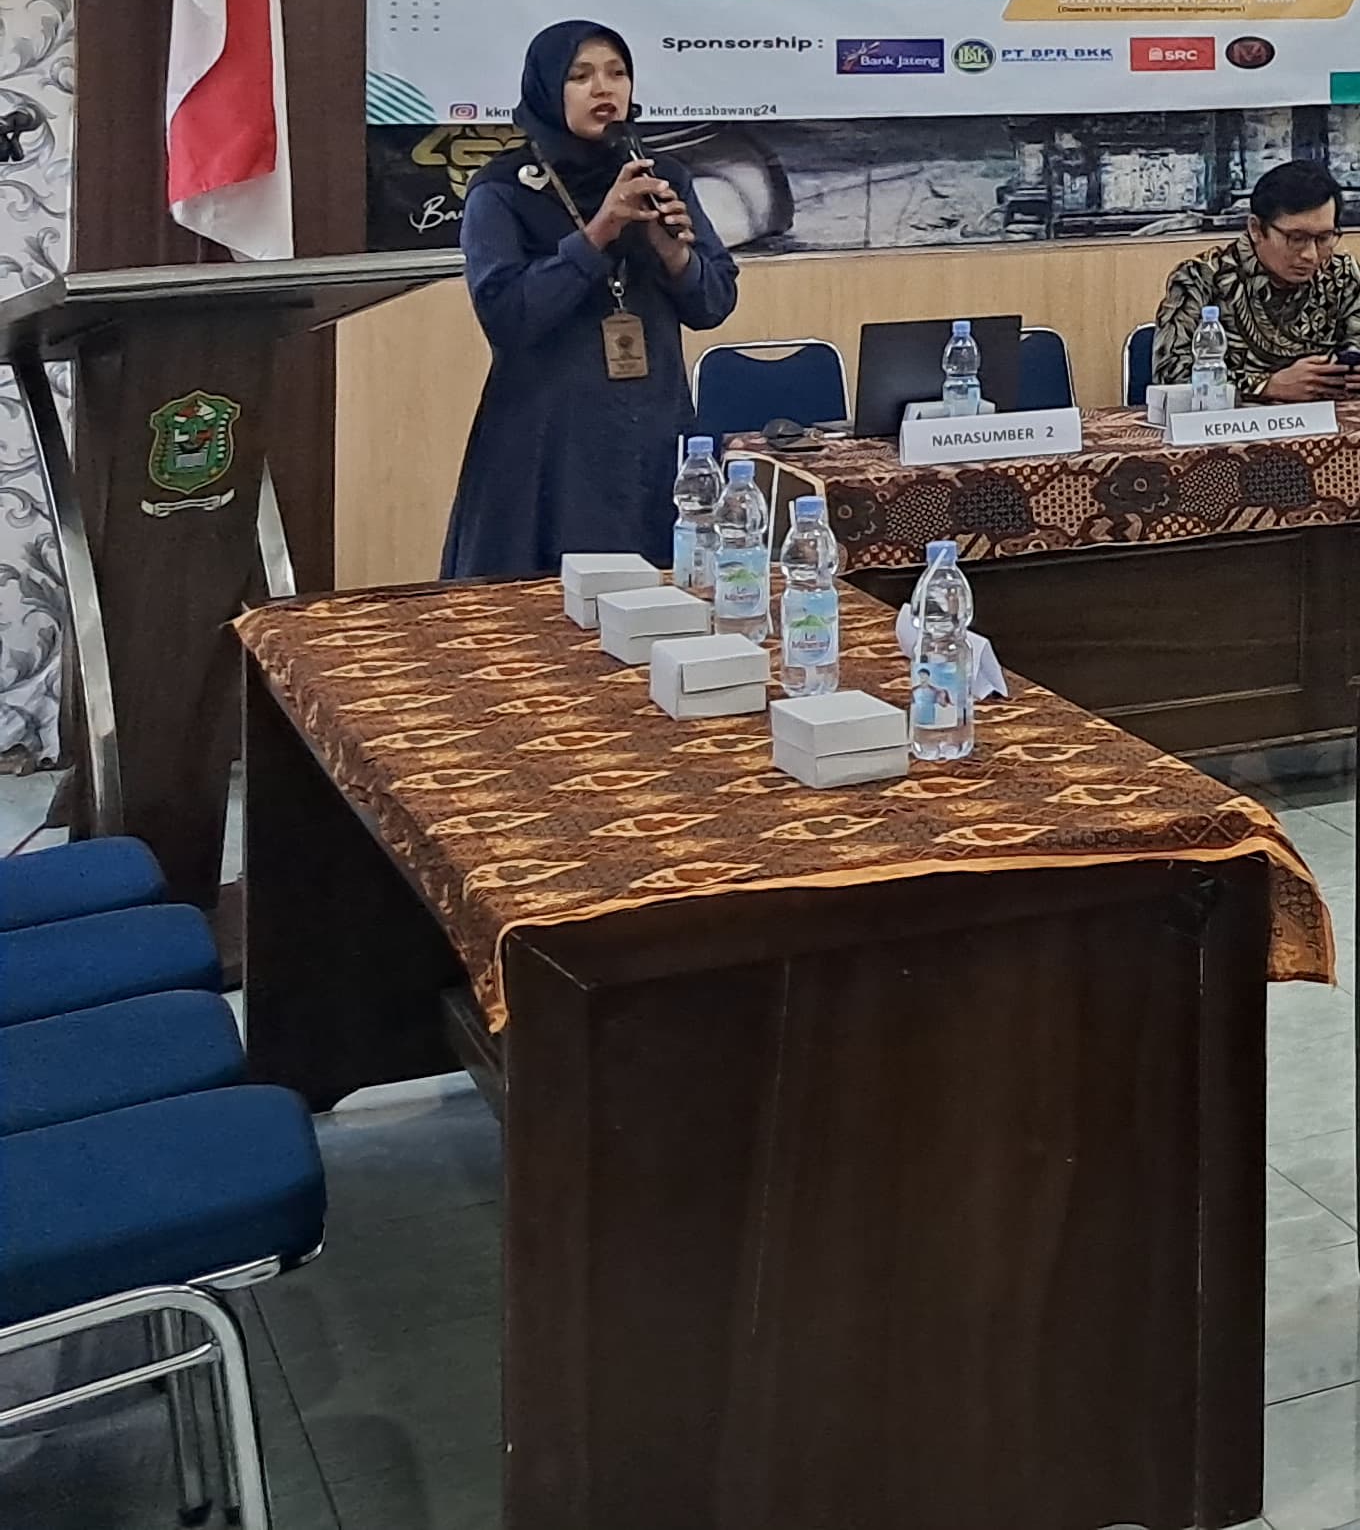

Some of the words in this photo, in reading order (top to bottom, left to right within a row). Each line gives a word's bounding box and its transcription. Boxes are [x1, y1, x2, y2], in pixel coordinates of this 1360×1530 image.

[662, 36, 812, 52] Sponsorship
[1001, 48, 1023, 58] PT
[1074, 48, 1113, 58] BKK
[1164, 49, 1198, 61] SRC
[860, 54, 894, 66] Bank
[897, 55, 940, 68] Jateng
[1204, 420, 1260, 437] KEPALA
[1267, 417, 1306, 431] DESA
[931, 428, 1035, 448] NARASUMBER
[1045, 426, 1055, 439] 2
